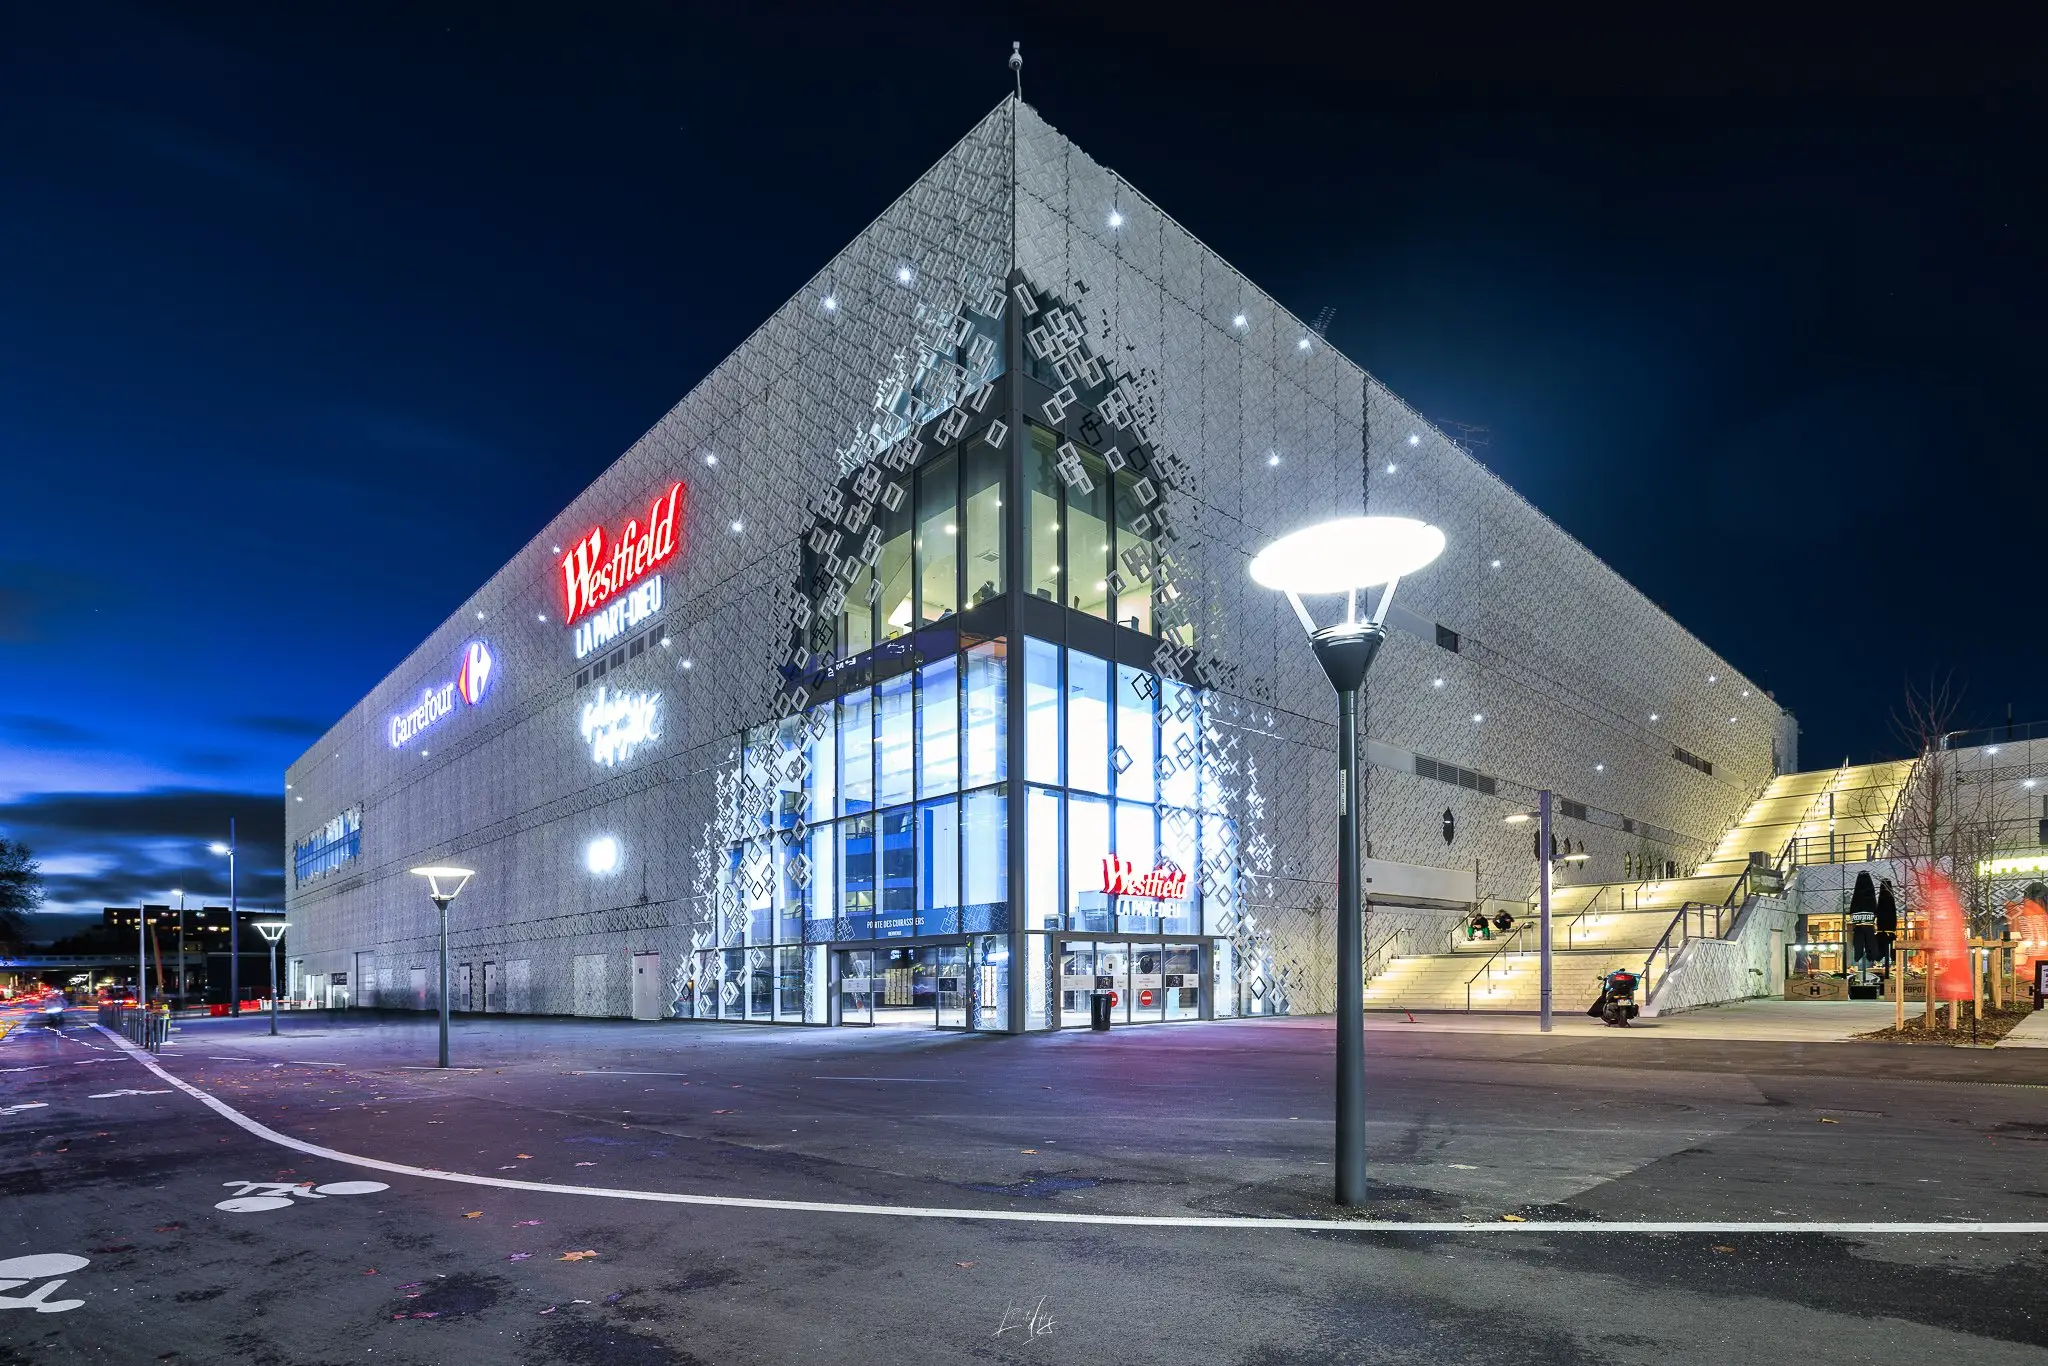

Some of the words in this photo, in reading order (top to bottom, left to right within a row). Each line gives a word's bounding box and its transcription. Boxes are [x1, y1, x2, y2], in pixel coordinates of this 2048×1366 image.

[561, 481, 684, 625] Westfield
[576, 624, 592, 659] LA
[593, 574, 663, 647] PART-DIEU
[391, 683, 454, 748] Carrefour
[1102, 854, 1188, 899] Westfield
[883, 919, 892, 928] DES
